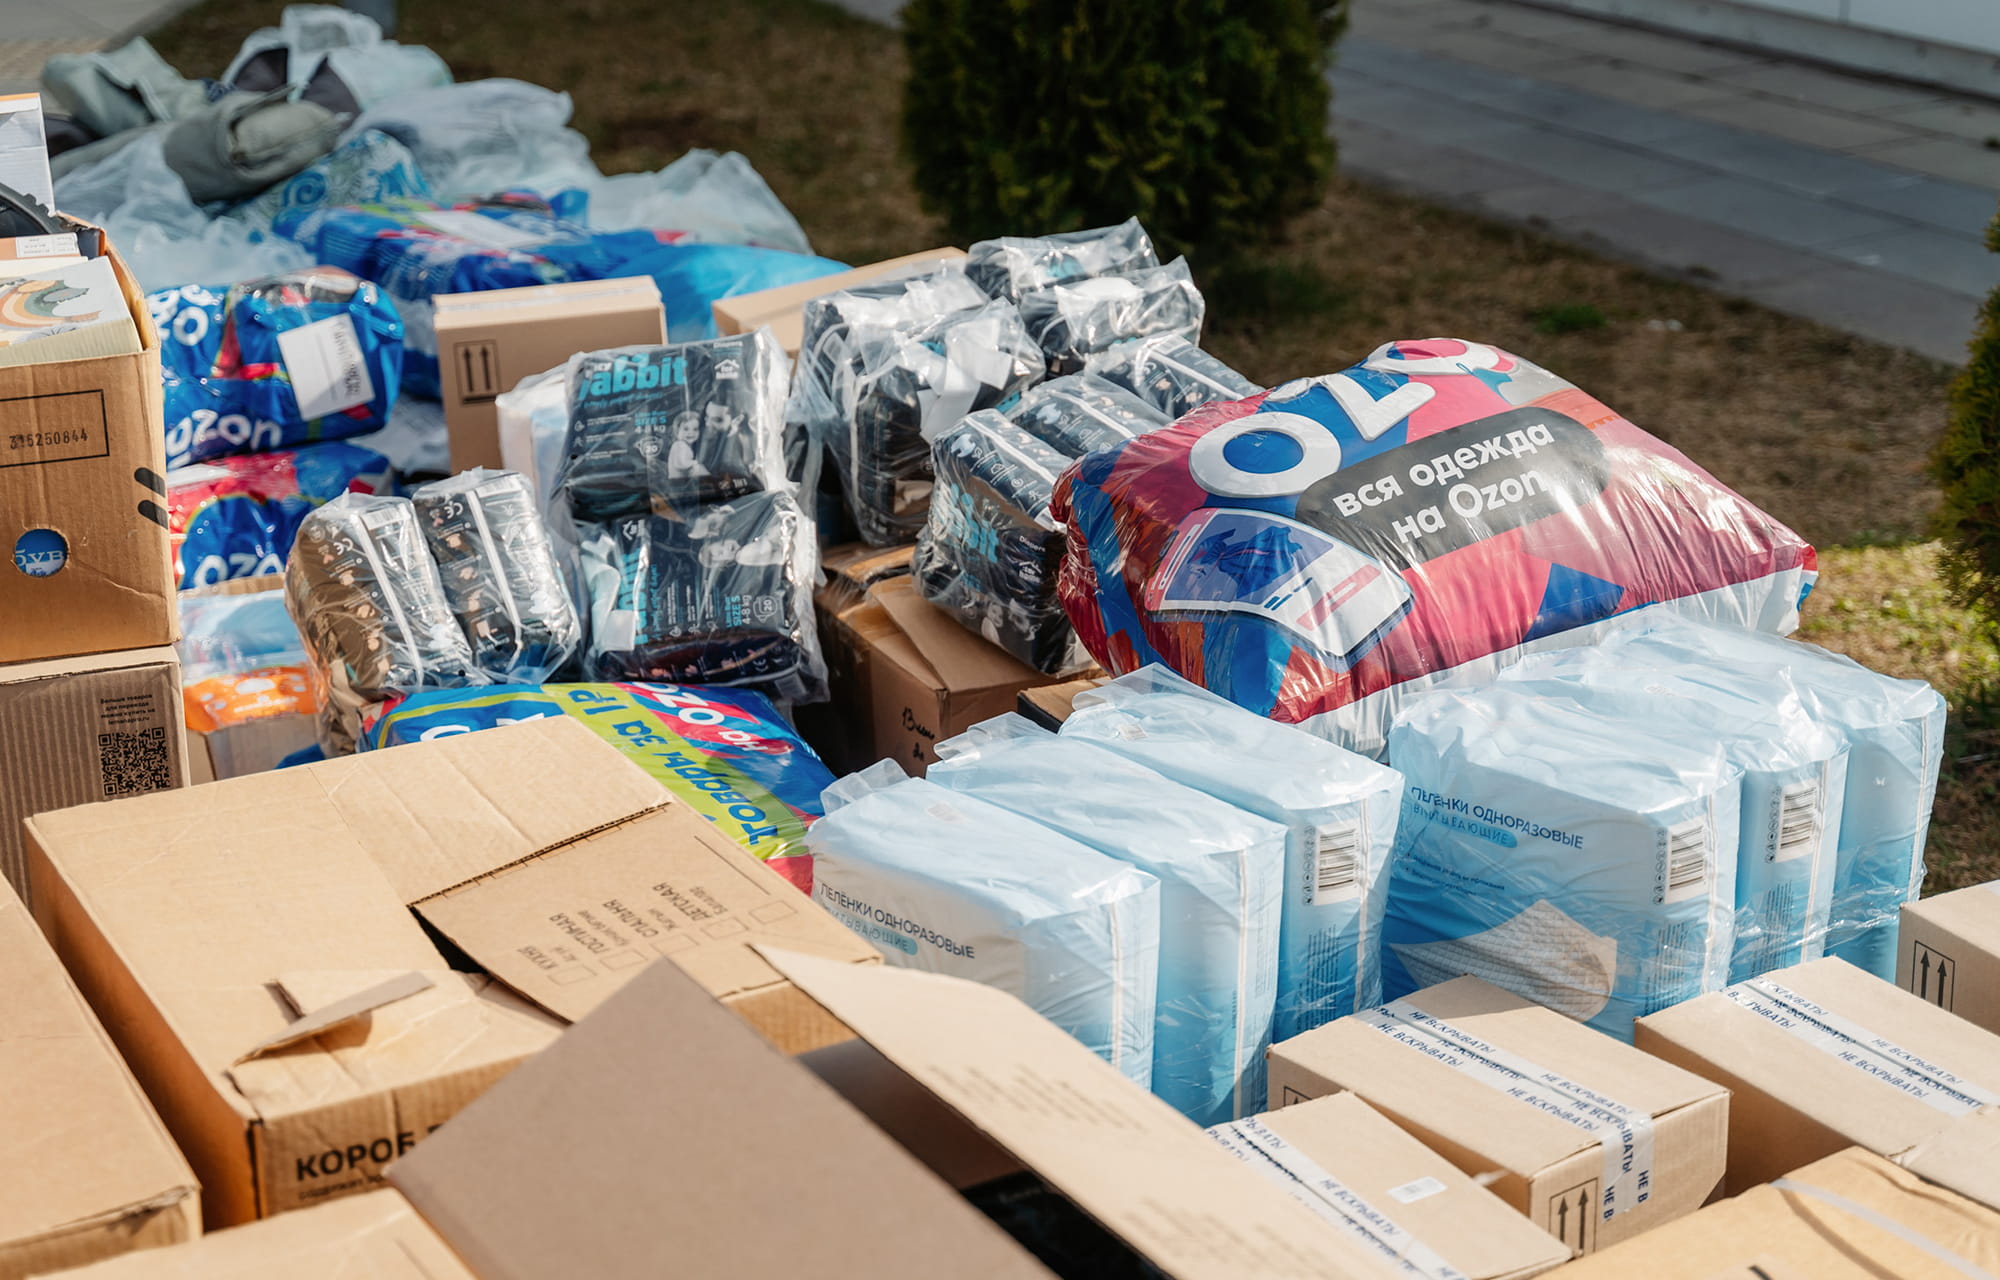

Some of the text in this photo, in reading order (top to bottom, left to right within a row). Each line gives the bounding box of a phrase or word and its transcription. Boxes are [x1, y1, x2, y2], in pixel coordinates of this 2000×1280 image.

[1332, 422, 1556, 518] вся одежда
[1391, 468, 1549, 545] на Ozon
[612, 719, 669, 748] за
[1472, 804, 1585, 850] ОДНОРАЗОВЫЕ
[874, 908, 975, 959] ОДНОРАЗОВЫЕ
[1377, 1023, 1465, 1068] НЕ ВСКРЫВАТЬ!
[1838, 1050, 1930, 1099] НЕ ВСКРЫВАТЬ!
[1506, 1087, 1601, 1132] НЕ ВСКРЫВАТЬ!
[1602, 1185, 1616, 1207] НЕ
[1637, 1169, 1649, 1190] НЕ
